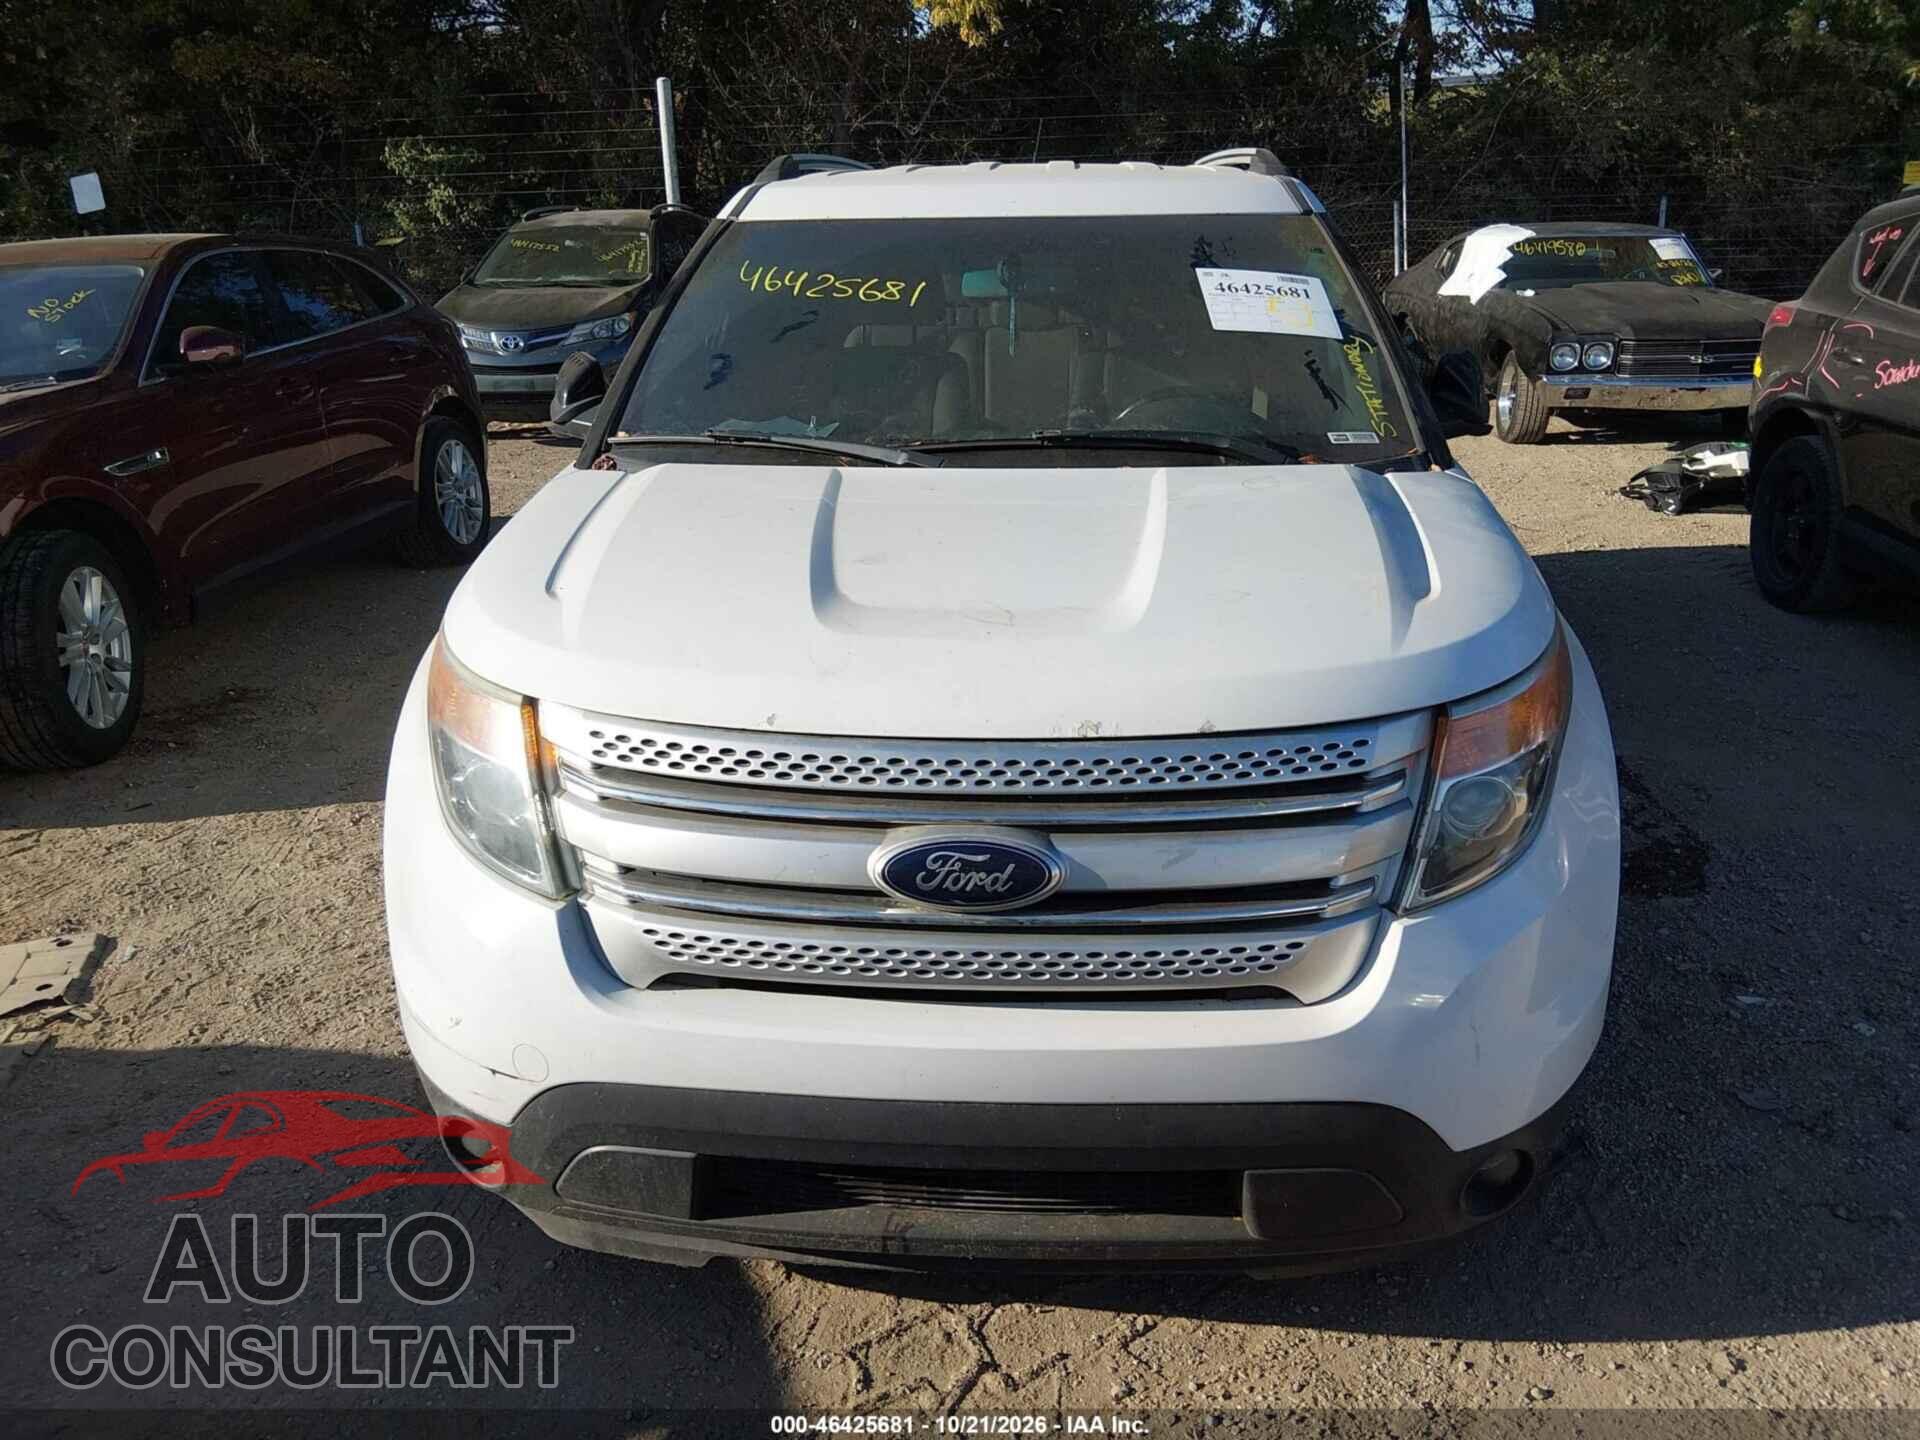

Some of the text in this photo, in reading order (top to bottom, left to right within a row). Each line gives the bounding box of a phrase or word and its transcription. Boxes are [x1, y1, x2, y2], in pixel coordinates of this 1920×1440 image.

[740, 260, 927, 308] 46425681
[1214, 282, 1310, 299] 46425681
[916, 851, 1016, 893] Ford
